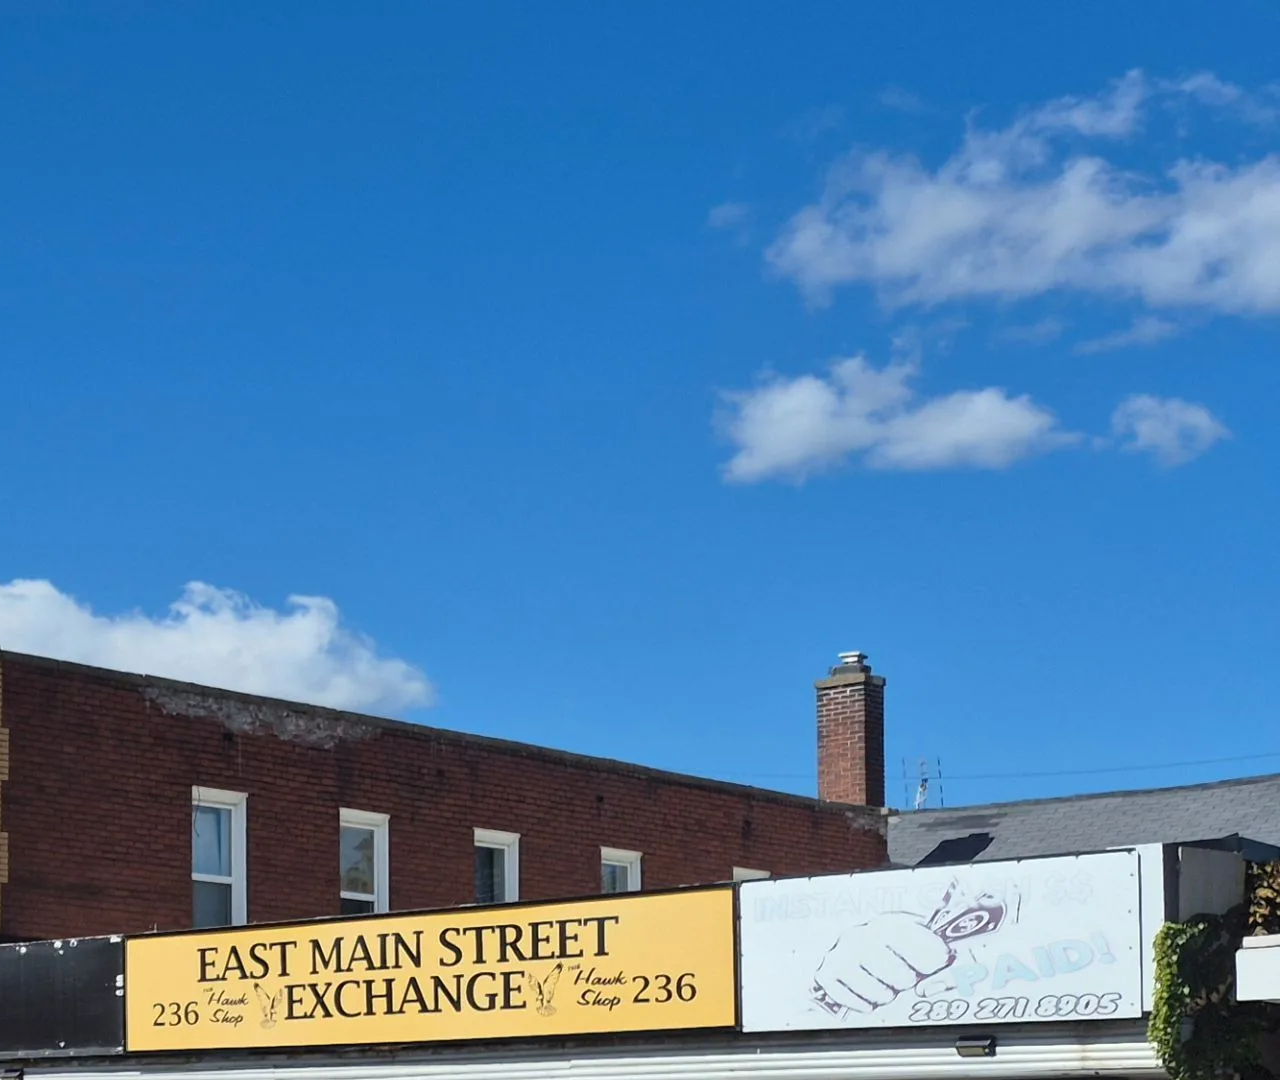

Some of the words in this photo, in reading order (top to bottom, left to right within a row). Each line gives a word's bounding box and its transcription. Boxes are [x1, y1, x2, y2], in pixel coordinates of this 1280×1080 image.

[197, 940, 297, 983] EAST
[308, 930, 424, 975] MAIN
[438, 916, 620, 968] STREET
[574, 967, 628, 986] Hawk
[948, 931, 1117, 997] PAID!
[207, 990, 249, 1006] Hawk
[284, 970, 527, 1022] EXCHANGE
[577, 989, 621, 1011] Shop
[632, 972, 697, 1004] 236
[152, 1001, 200, 1027] 236
[209, 1008, 244, 1028] Shop
[908, 998, 969, 1022] 289
[973, 997, 1030, 1020] 271
[1035, 992, 1123, 1017] 8905
